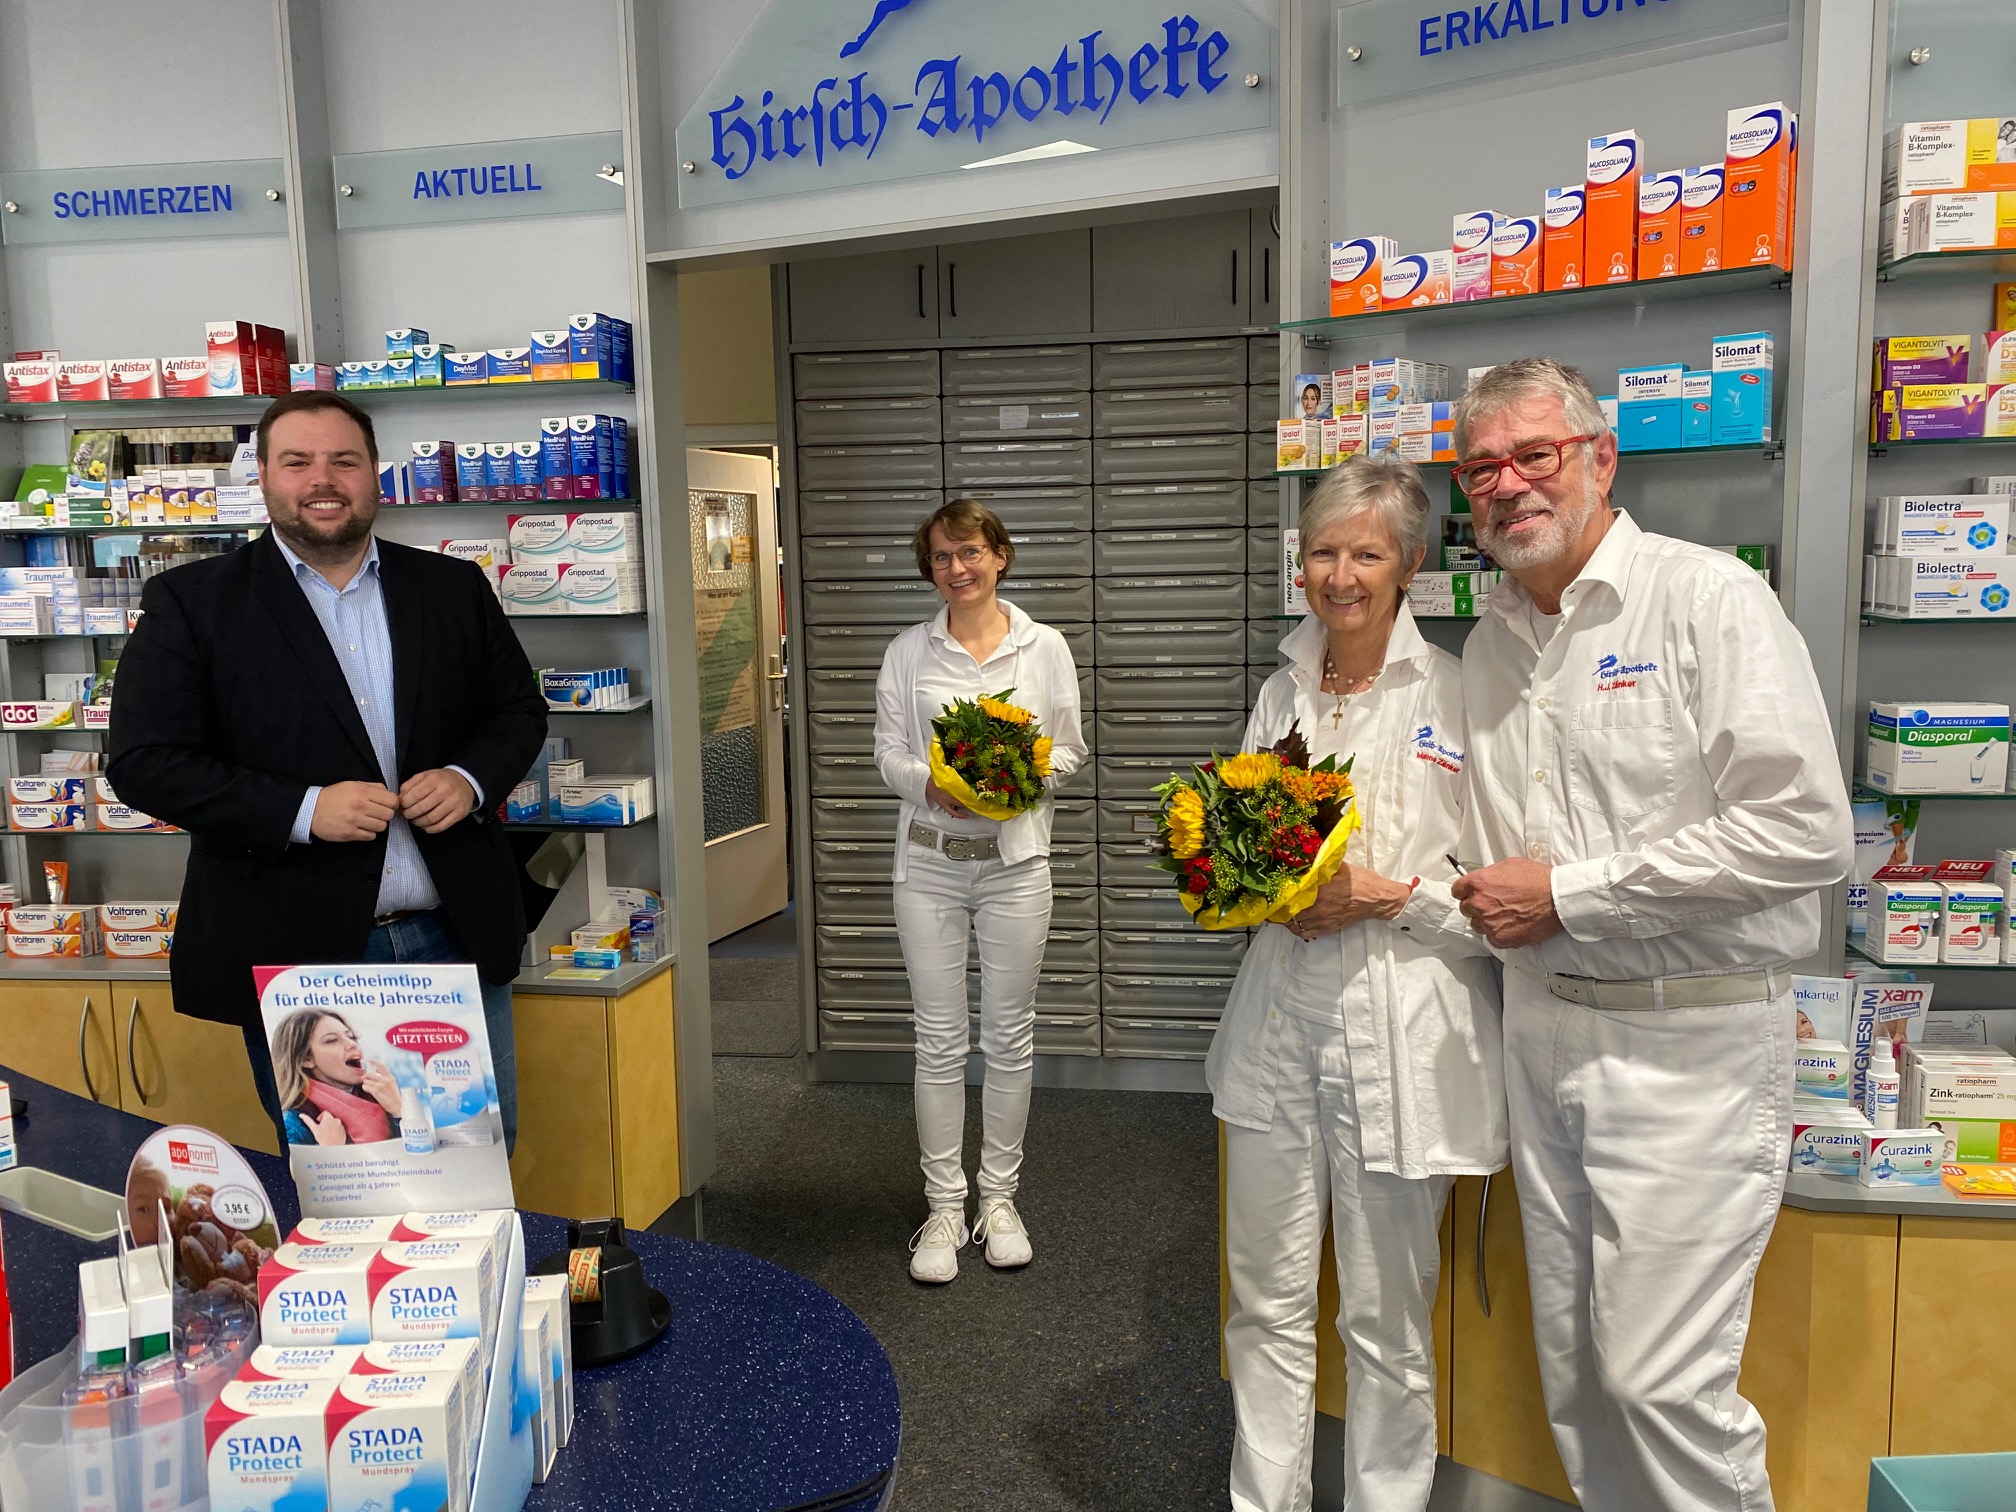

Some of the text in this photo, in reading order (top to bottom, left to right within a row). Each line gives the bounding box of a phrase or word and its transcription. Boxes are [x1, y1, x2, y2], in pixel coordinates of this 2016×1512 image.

[1730, 127, 1774, 141] MUCOSOLVAN
[1909, 134, 1941, 142] Vitamin
[1908, 143, 1956, 151] B-Komplex-
[1589, 156, 1631, 169] MUCOSOLVAN
[413, 163, 542, 199] AKTUELL
[1684, 184, 1720, 194] MUCOSOLVAN
[1641, 190, 1676, 201] MUCOSOLVAN
[53, 184, 233, 219] SCHMERZEN
[1547, 203, 1581, 215] MUCOSOLVAN
[1456, 226, 1488, 237] MUCODUAL
[1494, 232, 1527, 244] MUCOSOLVAN
[1332, 255, 1366, 267] MUCOSOLVAN
[1383, 270, 1419, 282] MUCOSOLVAN
[208, 330, 234, 339] Antistax
[1893, 340, 1945, 348] VIGANTOLVIT
[1715, 343, 1761, 358] Silomat
[58, 363, 101, 375] Antistax
[109, 361, 152, 373] Antistax
[164, 359, 208, 371] Antistax
[453, 364, 478, 373] DayMed
[7, 365, 49, 377] Antistax
[1625, 374, 1668, 387] Silomat
[1684, 380, 1710, 388] Silomat
[1908, 389, 1961, 398] VIGANTOLVIT
[1904, 501, 1962, 512] Biolectra
[517, 520, 556, 529] Grippostad
[576, 518, 613, 527] Grippostad
[448, 544, 488, 553] Grippostad
[509, 569, 548, 578] Grippostad
[567, 569, 605, 578] Grippostad
[1917, 563, 1974, 574] Biolectra
[86, 613, 118, 621] Traumeel
[544, 678, 590, 689] BoxaGrippal
[4, 705, 37, 721] doc
[1908, 729, 1973, 744] Diasporal
[14, 779, 47, 788] Voltaren
[16, 806, 47, 814] Voltaren
[1947, 862, 1985, 870] NEU
[106, 906, 147, 916] Voltaren
[1891, 902, 1928, 910] Diasporal
[1952, 903, 1990, 911] Diasporal
[14, 912, 46, 920] Voltaren
[12, 936, 46, 944] Voltaren
[112, 933, 152, 943] Voltaren
[299, 974, 433, 989] Der Geheimtipp
[274, 992, 463, 1008] für die kalte Jahreszeit
[1880, 989, 1924, 1004] xam
[392, 1034, 463, 1045] JETZT TESTEN
[1853, 989, 1880, 1101] MAGNESIUM
[433, 1060, 471, 1068] STADA
[435, 1068, 471, 1076] Protect
[1877, 1081, 1899, 1090] xam
[1804, 1132, 1861, 1146] Curazink
[1880, 1143, 1932, 1156] Curazink
[315, 1159, 399, 1169] Schützt und beruhigt
[317, 1167, 443, 1181] strapazierte Mundschleimhäute
[319, 1183, 354, 1193] Geeignet
[356, 1182, 367, 1190] ab
[374, 1181, 401, 1190] Jahren
[224, 1203, 250, 1215] 3,95 €
[279, 1290, 347, 1308] STADA
[389, 1286, 458, 1304] STADA
[281, 1306, 348, 1323] Protect
[391, 1303, 458, 1319] Protect
[291, 1326, 340, 1335] Mundspray
[401, 1322, 451, 1331] Mundspray
[348, 1427, 424, 1448] STADA
[227, 1435, 302, 1456] STADA
[350, 1445, 424, 1464] Protect
[229, 1454, 302, 1472] Protect
[361, 1466, 415, 1476] Mundspray
[240, 1474, 294, 1485] Mundspray
